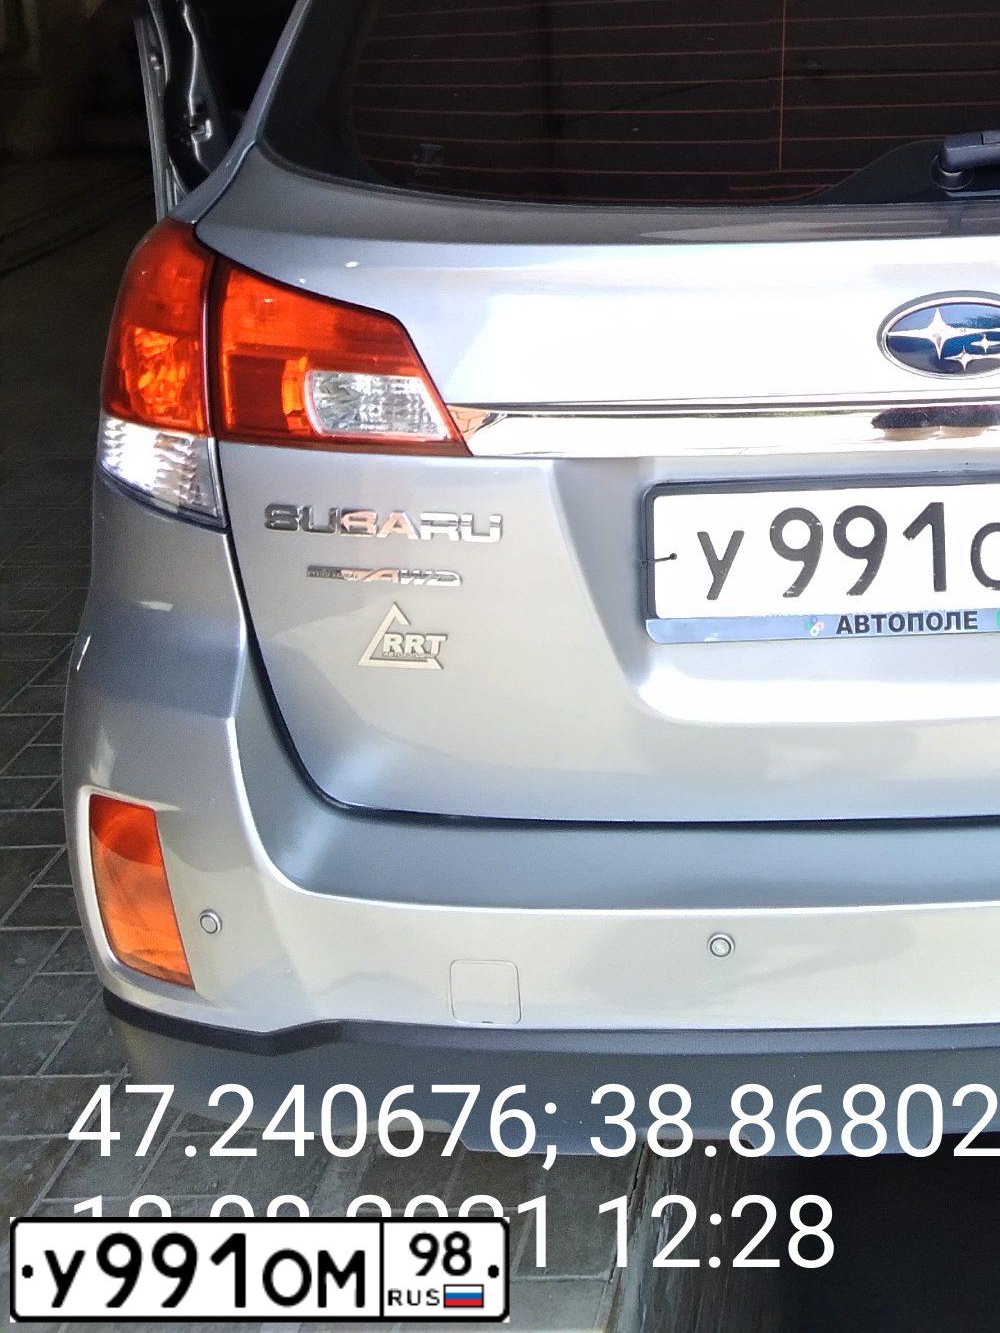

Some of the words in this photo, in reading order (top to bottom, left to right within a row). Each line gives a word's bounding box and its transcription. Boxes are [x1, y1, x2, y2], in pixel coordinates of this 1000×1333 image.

[264, 503, 503, 543] SUBARU
[362, 567, 463, 587] AWD
[836, 611, 978, 635] АВТОПОЛЕ
[382, 632, 448, 655] RRT
